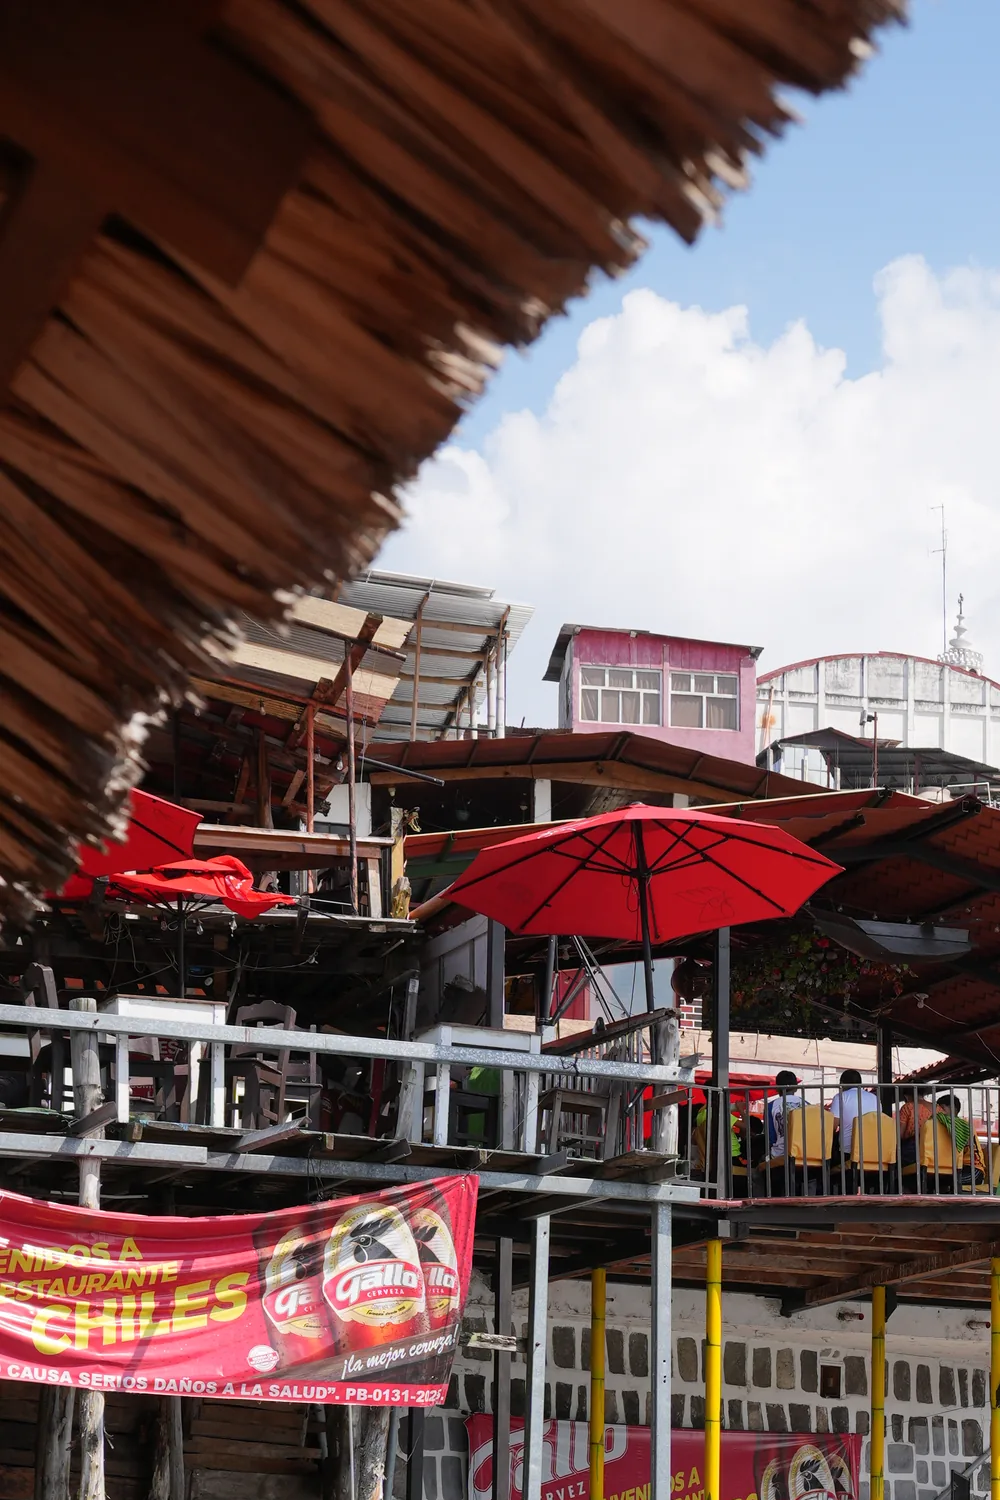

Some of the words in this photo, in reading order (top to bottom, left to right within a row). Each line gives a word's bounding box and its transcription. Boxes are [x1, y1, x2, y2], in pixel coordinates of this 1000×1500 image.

[118, 1237, 143, 1262] A
[367, 1288, 405, 1298] CERVEZA
[32, 1272, 250, 1356] CHILES
[367, 1348, 406, 1369] mejor
[409, 1324, 459, 1358] cerveza!
[7, 1364, 73, 1384] CAUSA
[78, 1371, 148, 1390] SERIOS
[154, 1377, 217, 1394] DAÑOS
[221, 1382, 235, 1395] A
[240, 1384, 263, 1397] LA
[688, 1466, 701, 1488] A
